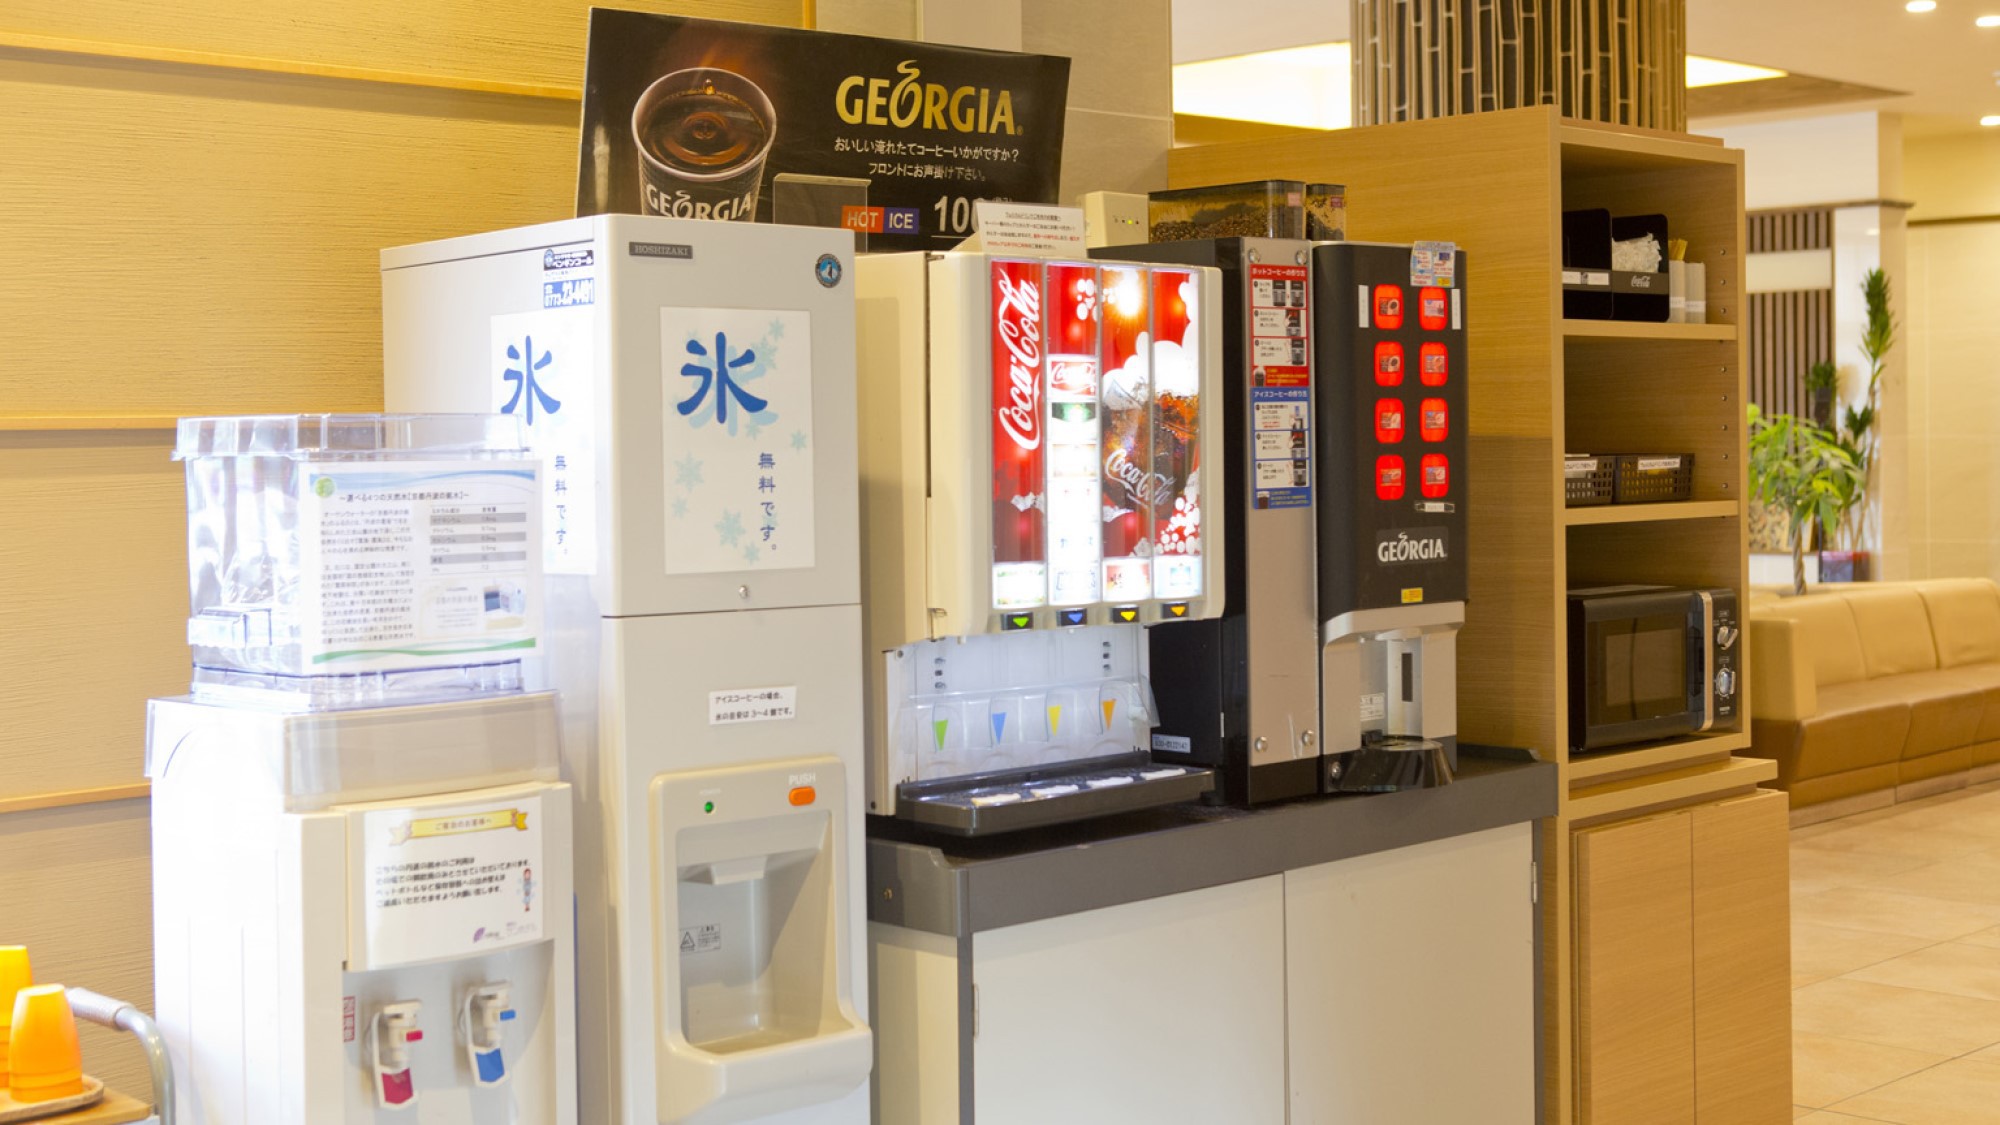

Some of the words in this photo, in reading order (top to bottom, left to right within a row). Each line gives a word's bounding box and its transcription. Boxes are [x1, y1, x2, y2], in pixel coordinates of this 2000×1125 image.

[835, 60, 1019, 136] GEORGIA
[634, 244, 689, 256] HOSHIZAKI
[847, 211, 880, 229] HOT
[888, 212, 914, 229] ICE
[500, 334, 561, 426] 氷
[676, 332, 768, 424] 氷
[999, 268, 1040, 450] Coca-Cola
[757, 452, 777, 550] 無料です。
[1377, 532, 1446, 563] GEORGIA
[788, 772, 817, 786] PUSH
